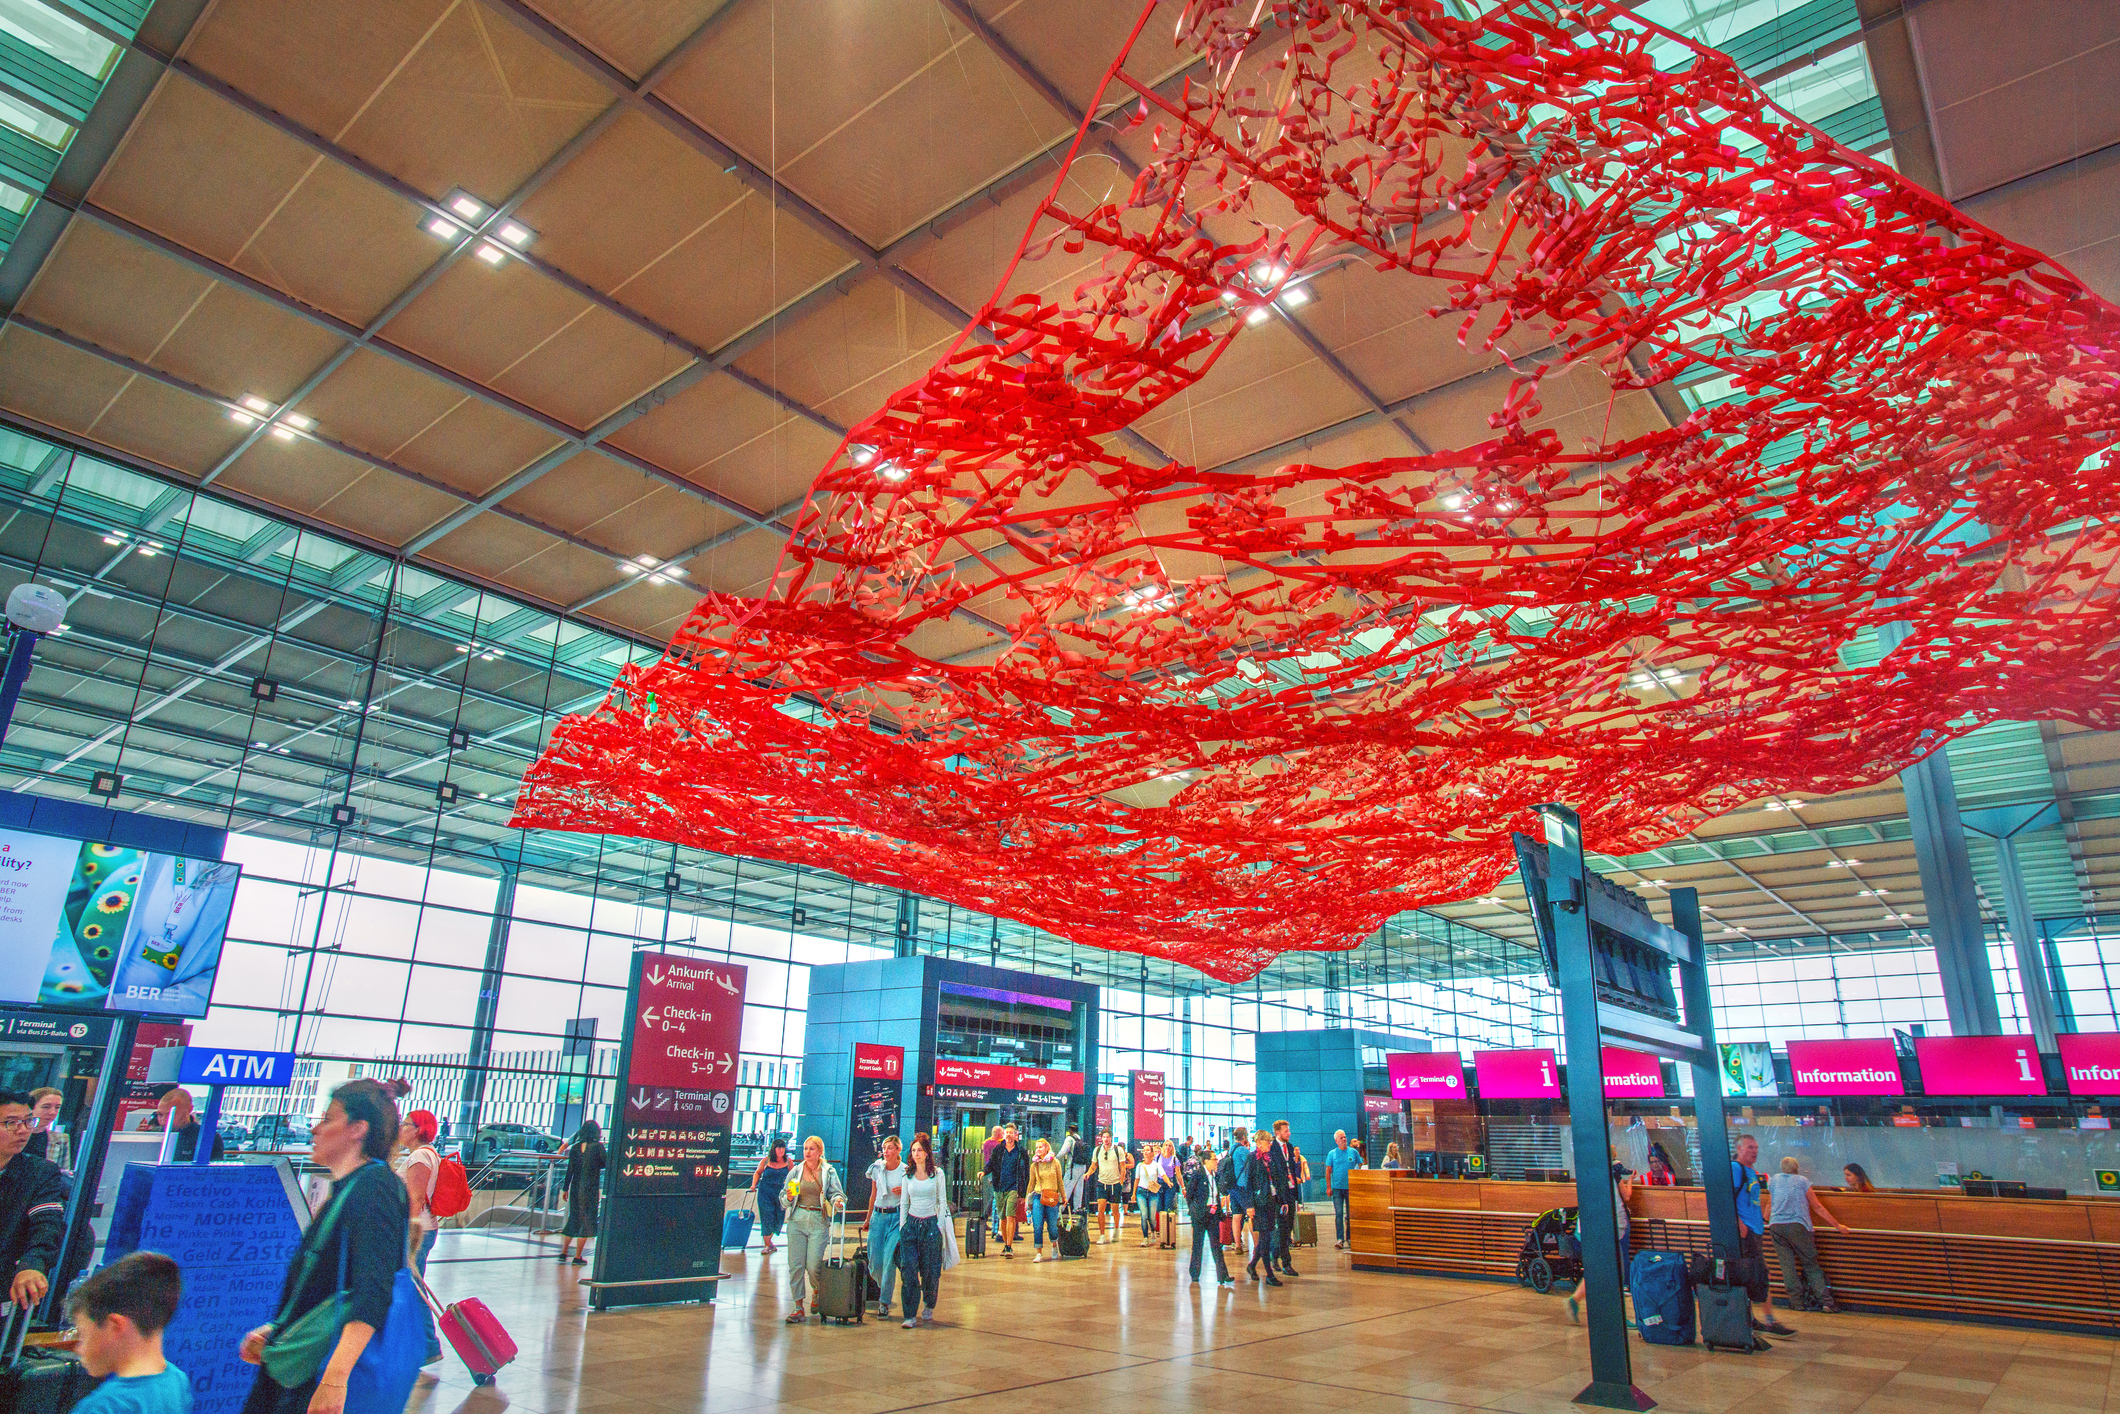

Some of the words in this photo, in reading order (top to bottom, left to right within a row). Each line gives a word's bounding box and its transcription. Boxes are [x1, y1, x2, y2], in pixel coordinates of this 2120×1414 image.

[668, 964, 714, 981] Ankunft
[666, 979, 695, 991] Arrival
[126, 985, 161, 1000] BER
[663, 1006, 712, 1022] Check-in
[19, 1020, 57, 1029] Terminal
[73, 1026, 86, 1035] T5
[666, 1045, 715, 1060] Check-in
[202, 1054, 276, 1080] ATM
[886, 1060, 897, 1071] T1
[1604, 1073, 1659, 1085] rmation
[1797, 1068, 1897, 1083] Information
[675, 1090, 712, 1101] Terminal
[681, 1103, 694, 1111] 450
[715, 1097, 727, 1109] T2
[166, 1184, 233, 1197] Efectivo
[210, 1198, 240, 1209] Cash
[245, 1196, 290, 1209] Kohle
[154, 1212, 190, 1222] Money
[177, 1229, 209, 1240] Pinke
[213, 1229, 244, 1239] Pinke
[183, 1247, 222, 1263] Geld
[194, 1272, 227, 1281] Kohle
[228, 1279, 282, 1293] Money
[229, 1296, 269, 1306] Dinero
[199, 1321, 234, 1333] Cash
[177, 1335, 237, 1353] Asche
[215, 1381, 249, 1392] Pinke
